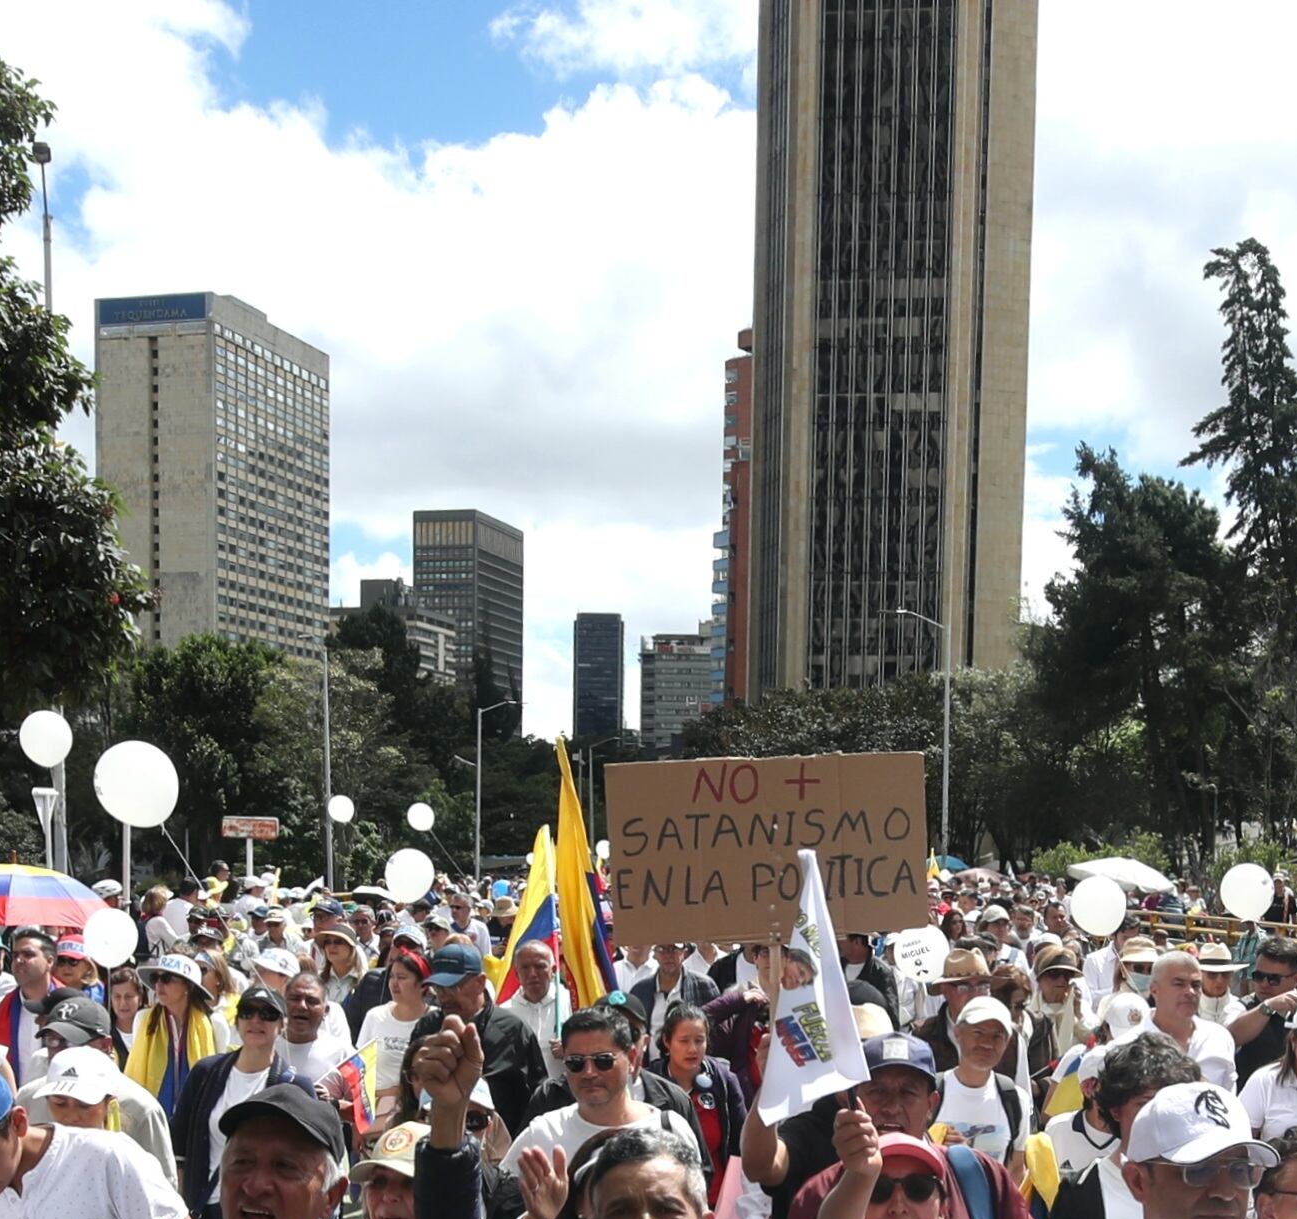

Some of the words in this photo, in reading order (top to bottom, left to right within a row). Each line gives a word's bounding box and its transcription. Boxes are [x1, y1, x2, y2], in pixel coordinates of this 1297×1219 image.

[692, 763, 760, 805] NO
[622, 807, 911, 858] SATANISMO
[752, 854, 918, 903] POITICA
[901, 946, 931, 959] MIGUEL
